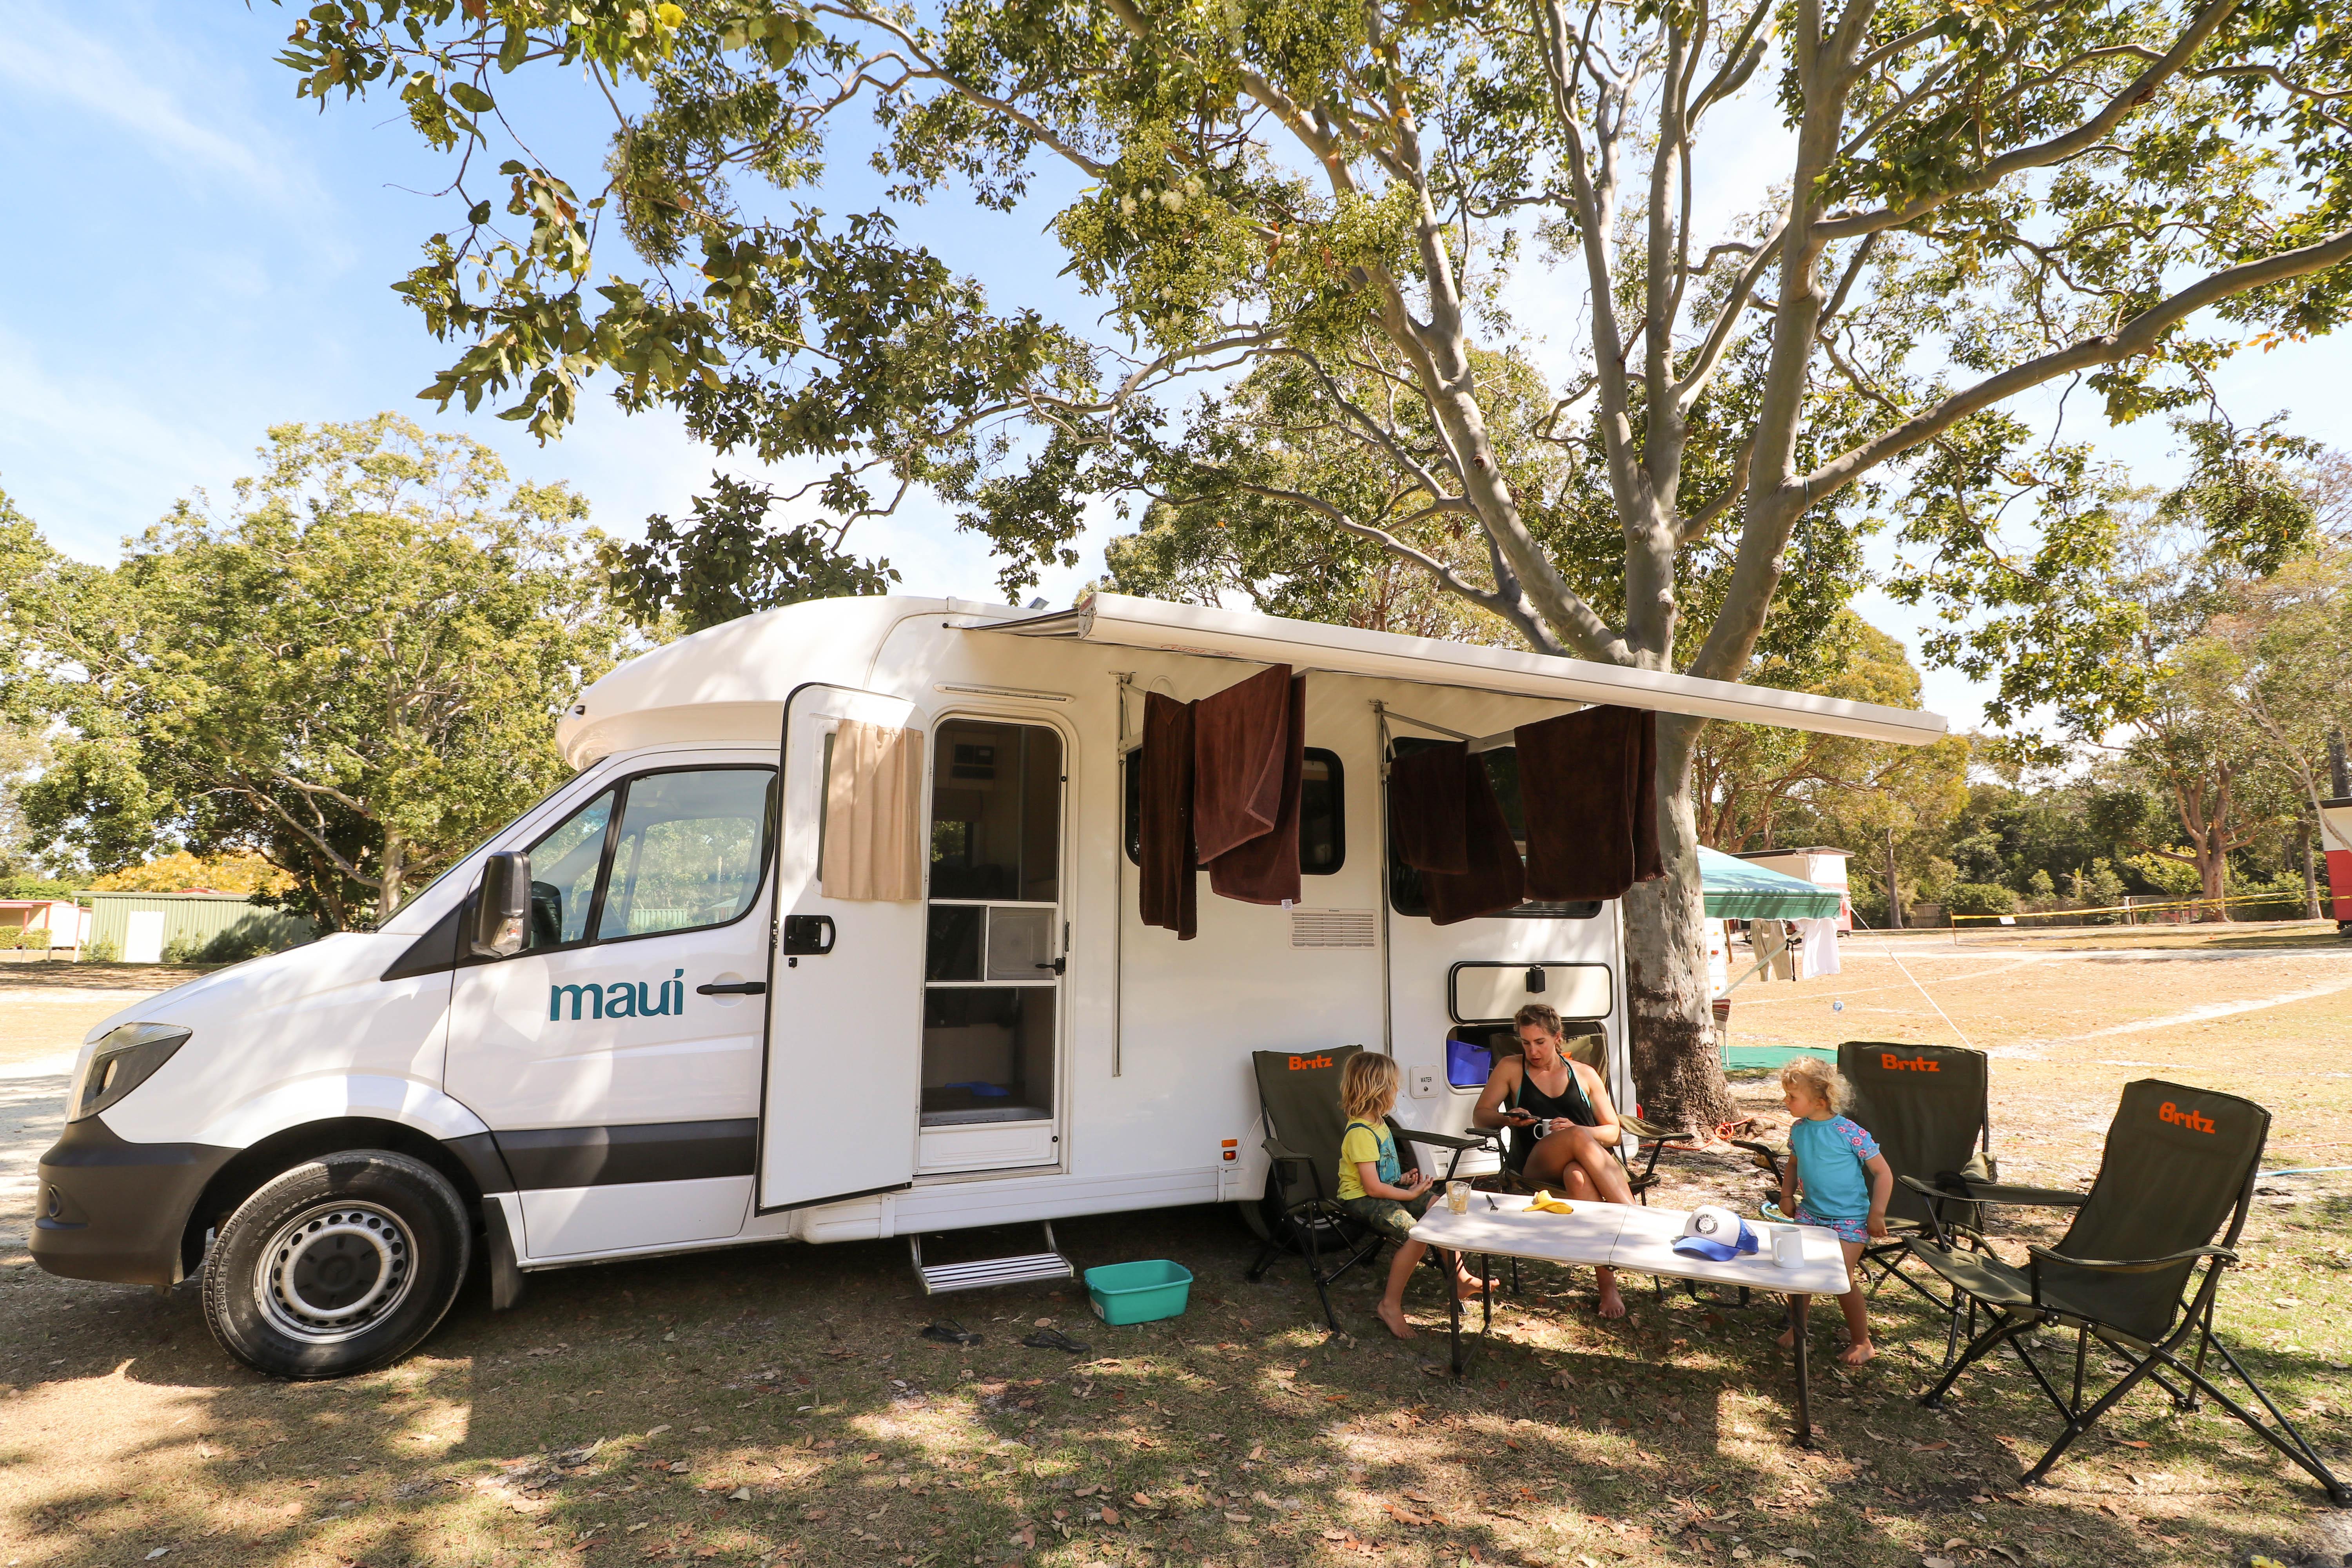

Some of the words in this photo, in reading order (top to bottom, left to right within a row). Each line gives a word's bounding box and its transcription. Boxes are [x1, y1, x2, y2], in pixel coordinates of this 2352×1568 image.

[1289, 1054, 1333, 1070] Britz
[1881, 1053, 1940, 1072] Britz
[2159, 1102, 2216, 1134] Britz
[221, 1257, 230, 1268] 16
[216, 1280, 227, 1314] 235/65
